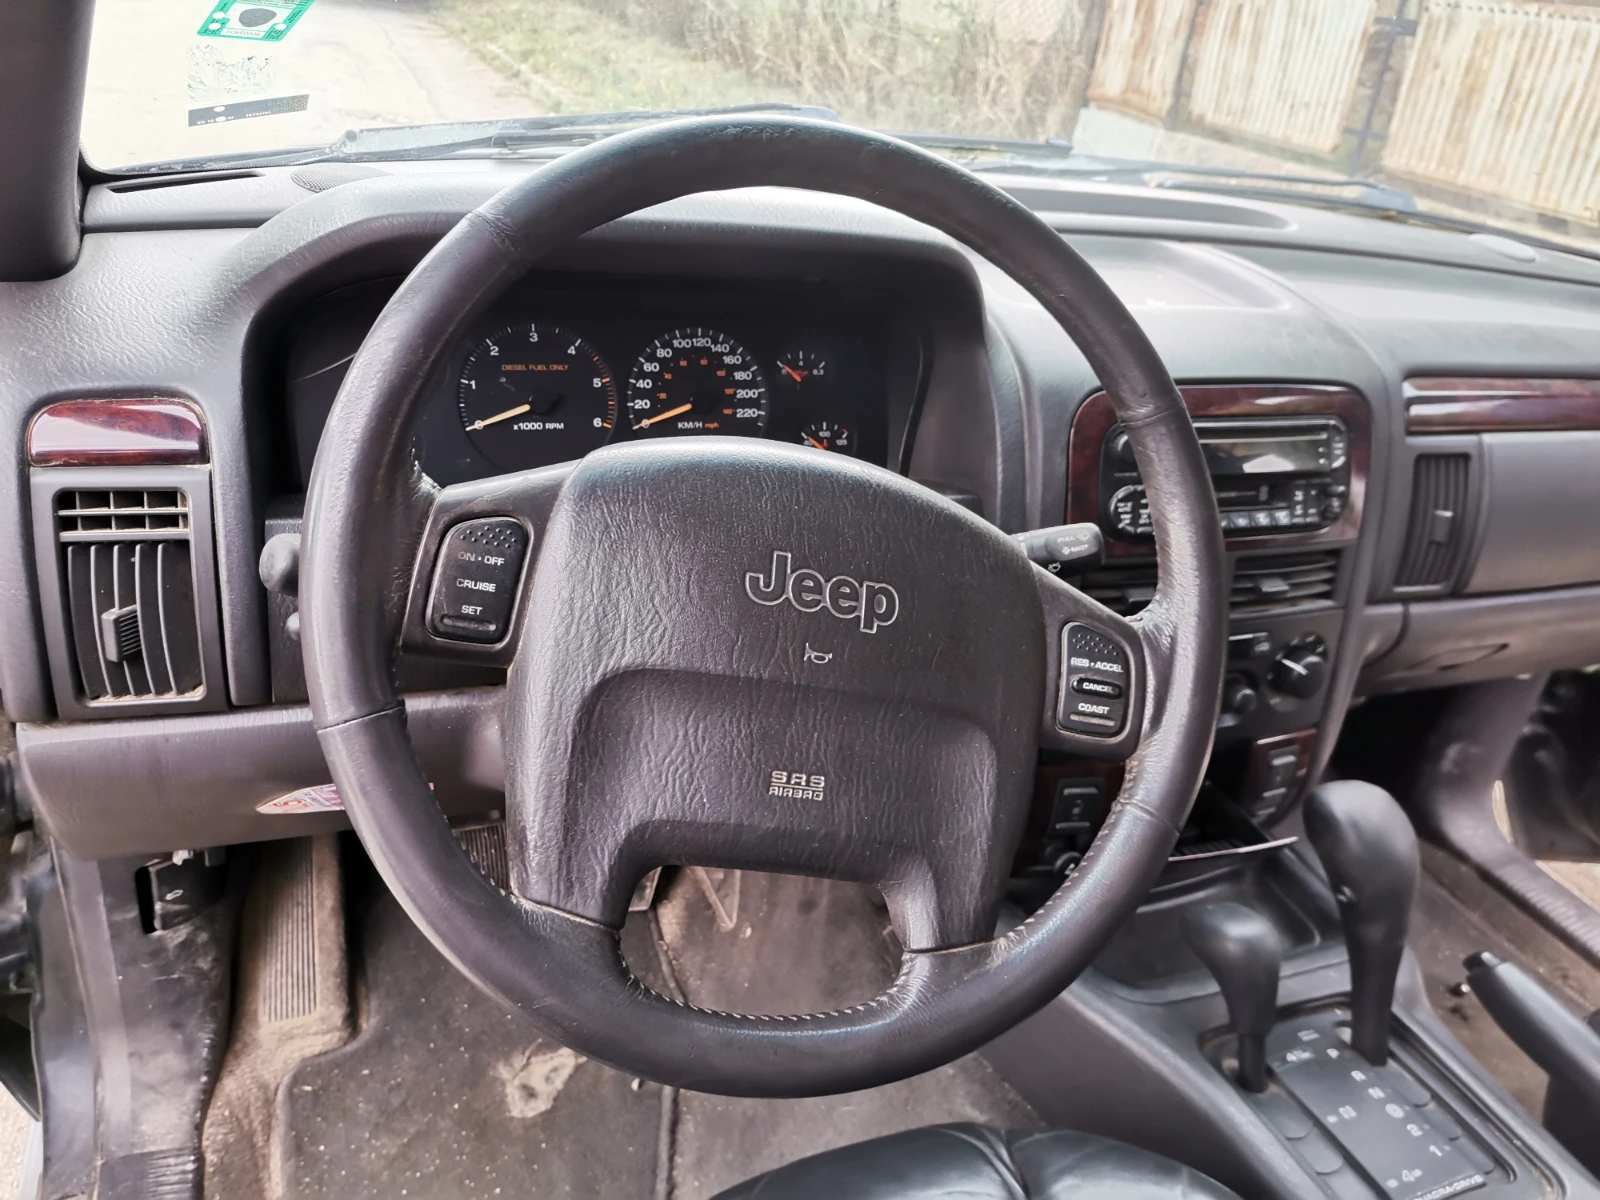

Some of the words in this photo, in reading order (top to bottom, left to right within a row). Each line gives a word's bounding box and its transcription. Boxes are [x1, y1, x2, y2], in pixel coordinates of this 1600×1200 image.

[529, 332, 538, 342] 3
[672, 339, 692, 348] 100
[692, 338, 711, 347] 120
[490, 346, 499, 356] 2
[567, 346, 576, 355] 4
[656, 348, 672, 358] 80
[711, 343, 730, 353] 140
[723, 355, 742, 364] 160
[643, 363, 659, 372] 60
[733, 371, 752, 380] 180
[469, 380, 476, 389] 1
[593, 379, 602, 388] 5
[636, 379, 652, 389] 40
[736, 389, 758, 398] 200
[634, 399, 650, 409] 20
[736, 408, 758, 418] 220
[513, 422, 543, 430] x1000
[593, 419, 602, 428] 6
[678, 421, 703, 429] KM/H
[458, 551, 475, 562] ON
[484, 555, 505, 566] OFF
[456, 578, 496, 592] CRUISE
[745, 550, 899, 634] Jeep
[461, 604, 483, 615] SET
[1071, 656, 1089, 668] RES
[1094, 661, 1124, 673] ACCEL
[1082, 682, 1114, 694] CANCEL
[1078, 702, 1110, 714] COAST
[771, 770, 825, 786] SRS
[768, 786, 824, 801] AIRBAG
[1406, 1123, 1423, 1137] 2
[1429, 1144, 1443, 1157] 1
